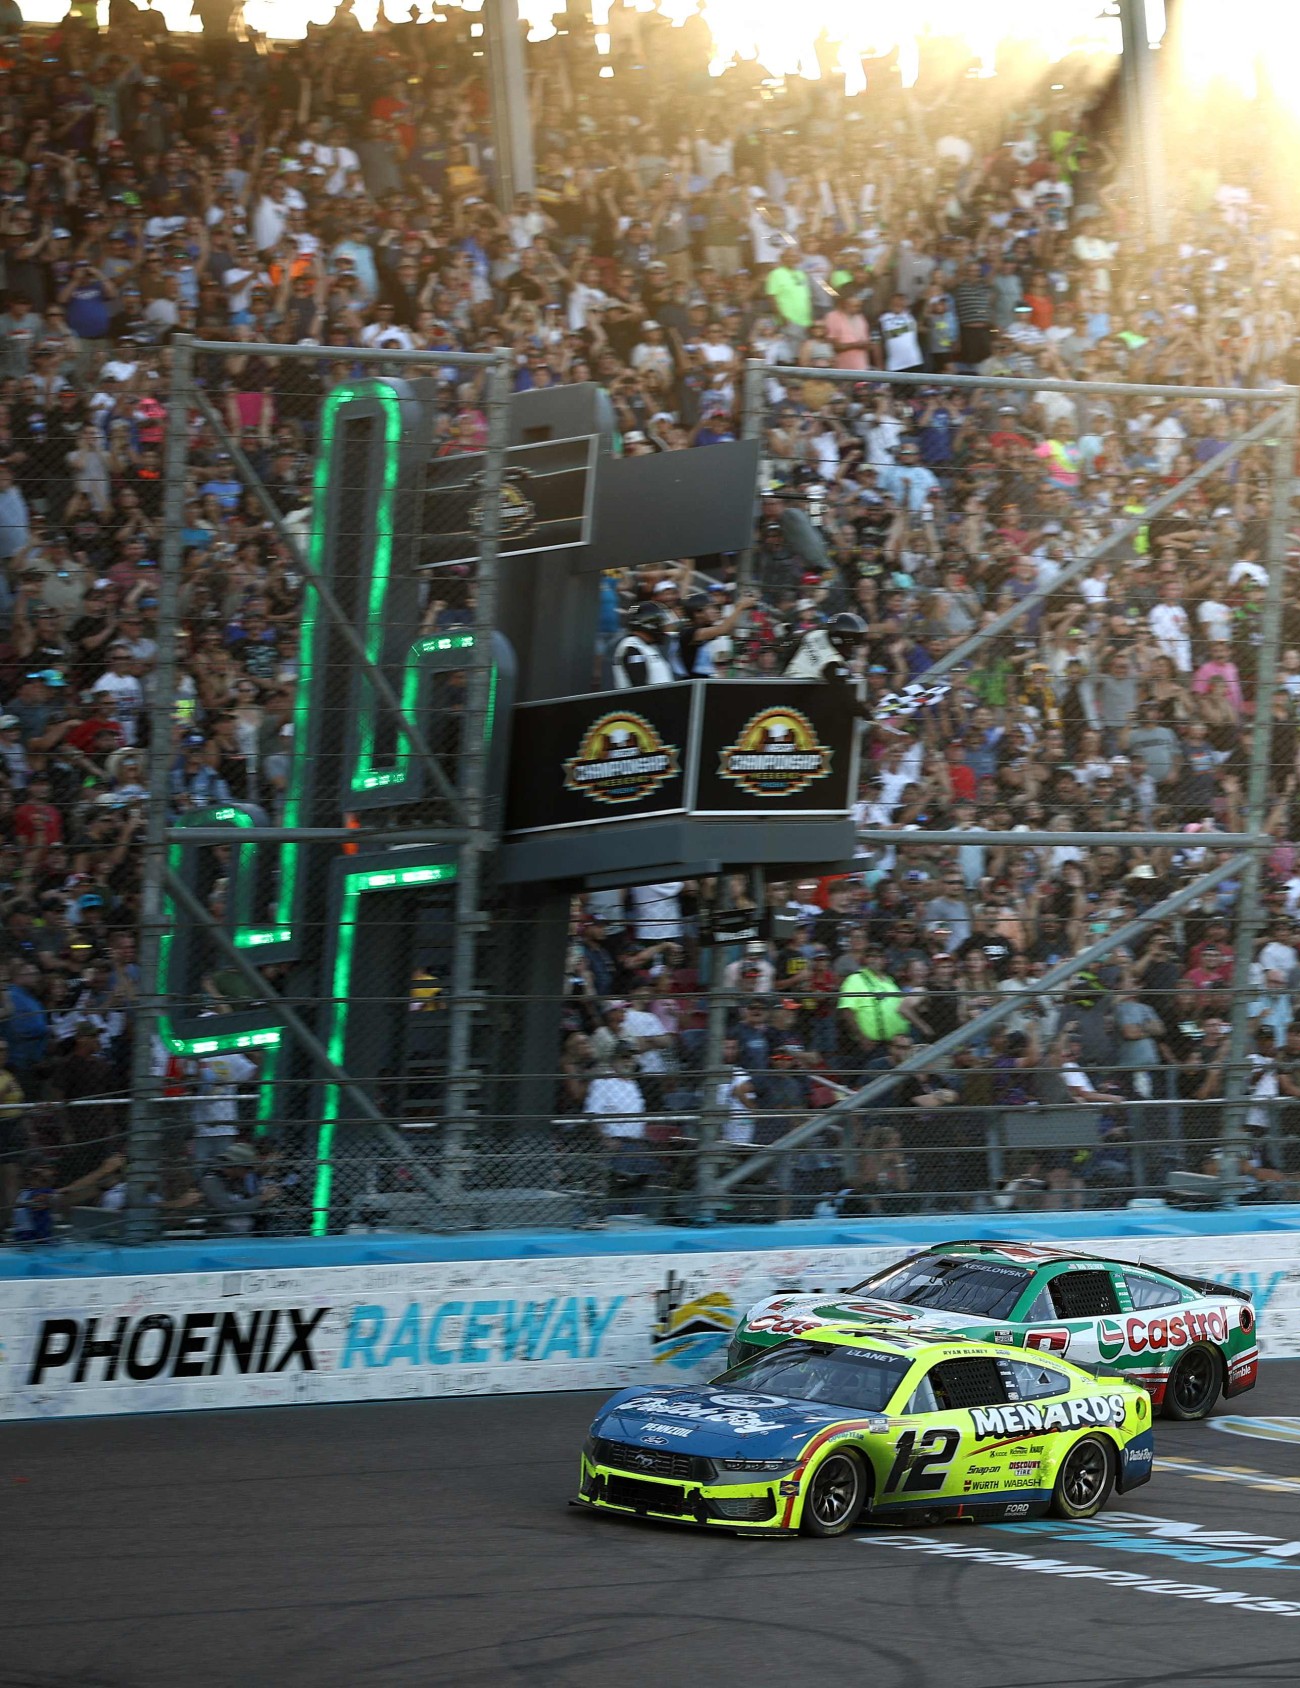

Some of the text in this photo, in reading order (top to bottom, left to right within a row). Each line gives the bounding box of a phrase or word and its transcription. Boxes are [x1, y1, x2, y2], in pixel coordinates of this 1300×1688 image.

[962, 1262, 1027, 1278] KESELOWSKI
[1126, 1306, 1228, 1353] Castrol
[28, 1295, 626, 1385] PHOENIX RACEWAY
[970, 1395, 1126, 1438] MENARDS
[640, 1423, 695, 1438] PENNZOIL
[883, 1428, 962, 1495] 12
[1009, 1461, 1041, 1469] DISCOUNT
[967, 1465, 1001, 1475] Snap-on
[1004, 1479, 1042, 1487] WABASH
[1005, 1503, 1029, 1513] FORD
